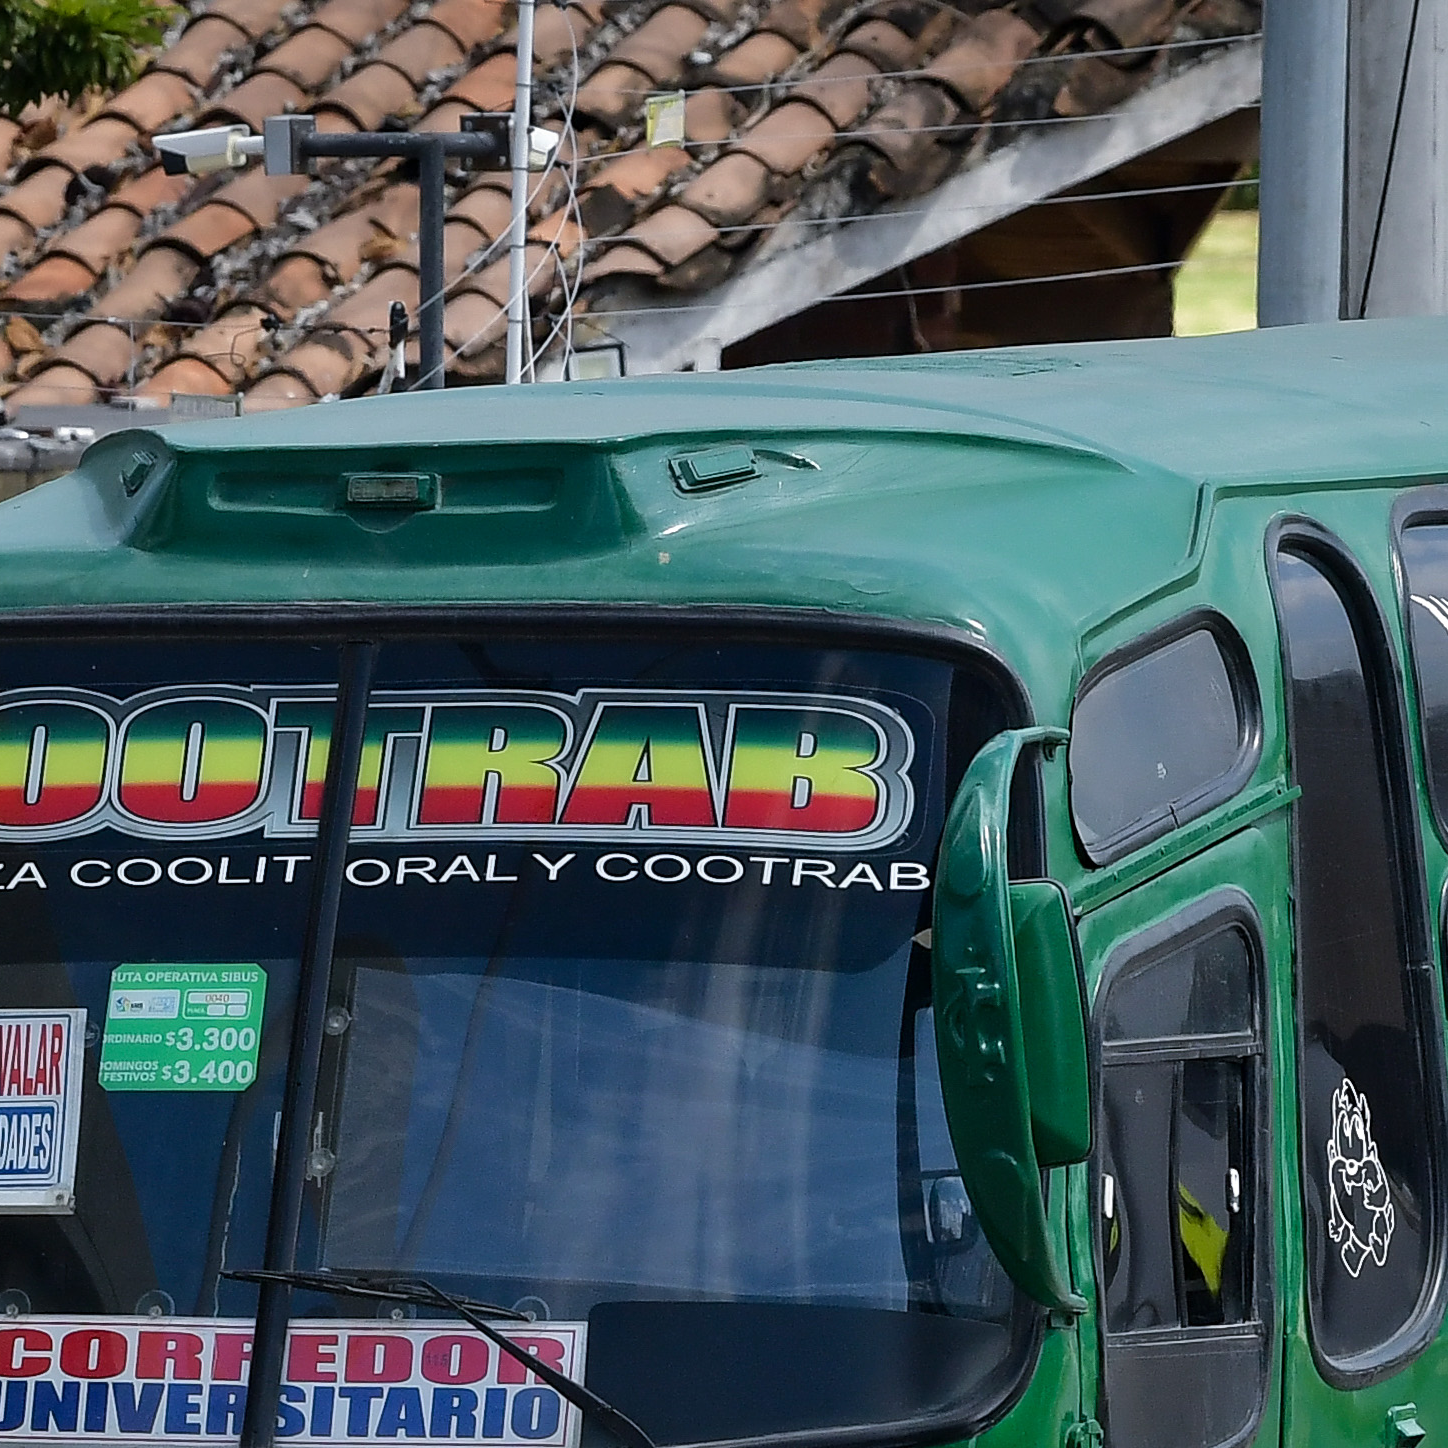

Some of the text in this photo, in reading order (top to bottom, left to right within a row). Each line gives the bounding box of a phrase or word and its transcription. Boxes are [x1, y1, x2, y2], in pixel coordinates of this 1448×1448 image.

[533, 853, 575, 880] Y
[595, 853, 930, 890] COOTRAB
[145, 971, 218, 982] OPERATIVA
[221, 972, 258, 982] SIBUS
[165, 1027, 256, 1051] $3.300
[161, 1060, 253, 1084] $3.400
